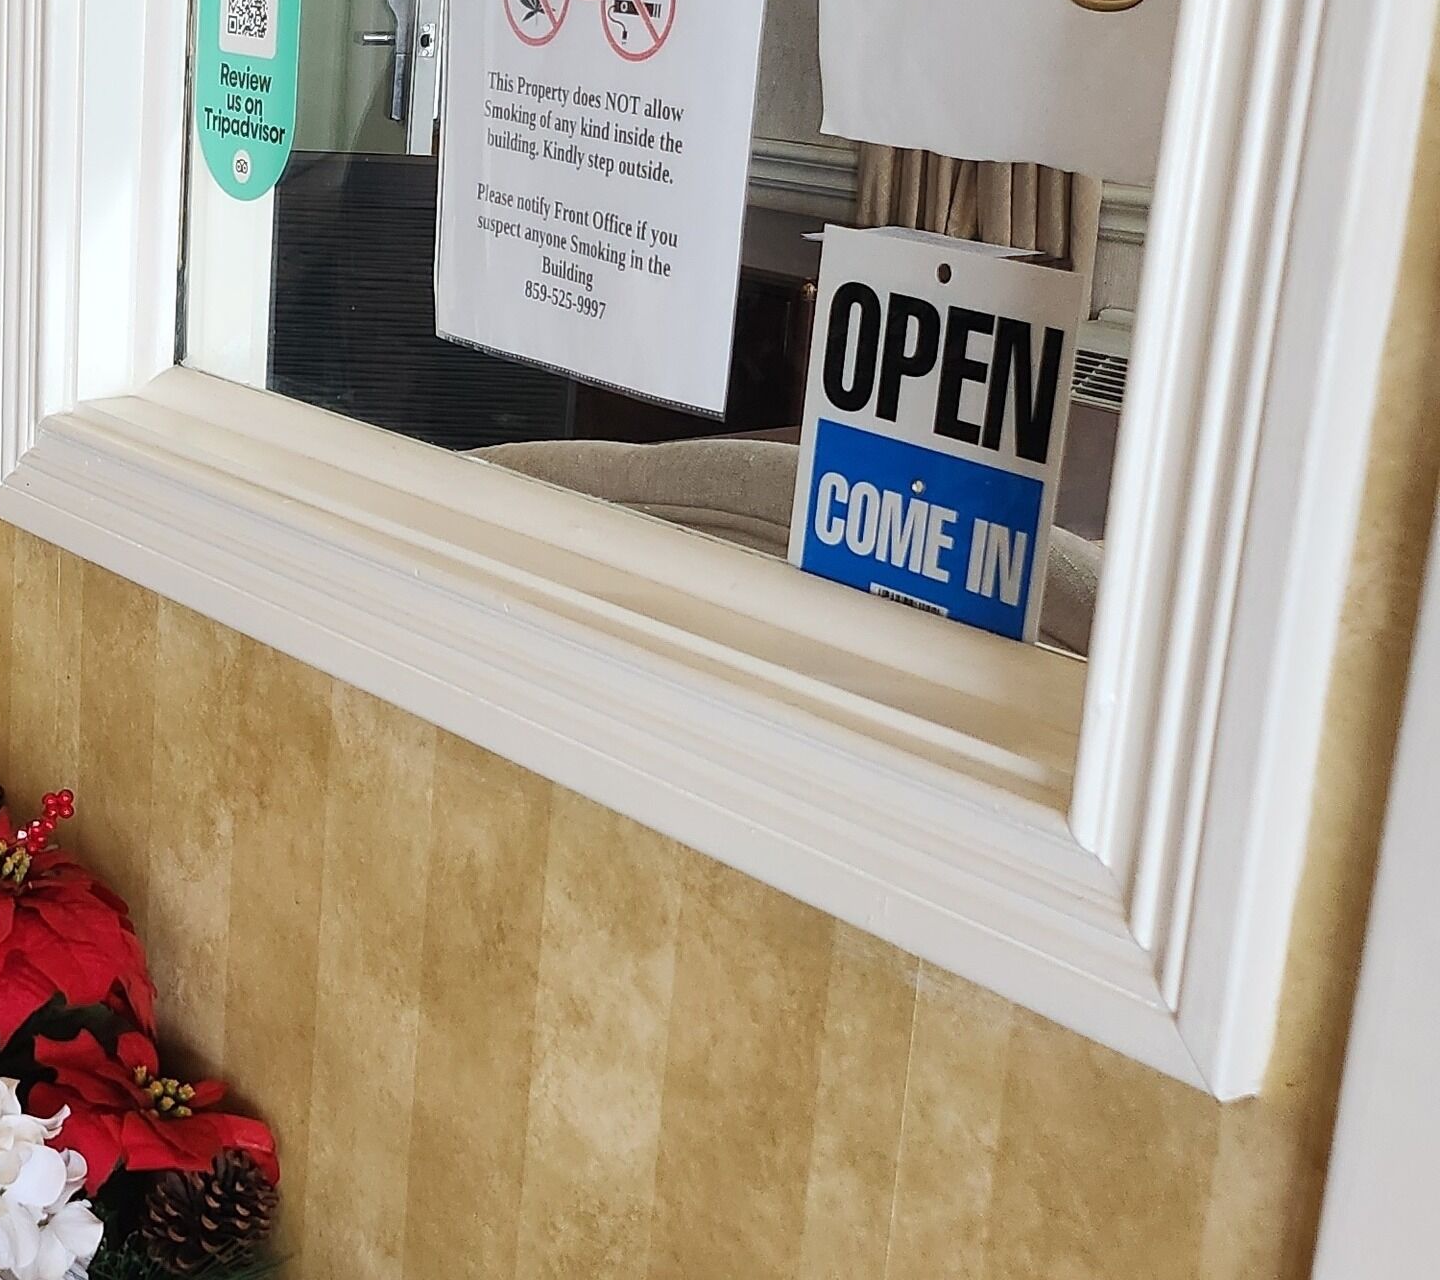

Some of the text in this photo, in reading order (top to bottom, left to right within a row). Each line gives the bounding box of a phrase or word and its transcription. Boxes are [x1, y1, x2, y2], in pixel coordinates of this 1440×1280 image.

[220, 62, 272, 93] Review
[487, 71, 685, 122] This Property does NOT allow
[204, 107, 286, 145] Tripadvisor
[226, 93, 264, 117] us on
[483, 99, 683, 154] Smoking of any kind inside the
[487, 127, 674, 185] building. Kindly step outside.
[477, 182, 679, 249] Please notify Front Office if you
[476, 214, 672, 278] suspect anyone Smoking in the
[524, 279, 607, 320] 859-525-9997
[541, 255, 594, 292] Building
[822, 280, 1065, 465] OPEN
[813, 471, 1029, 608] COME IN
